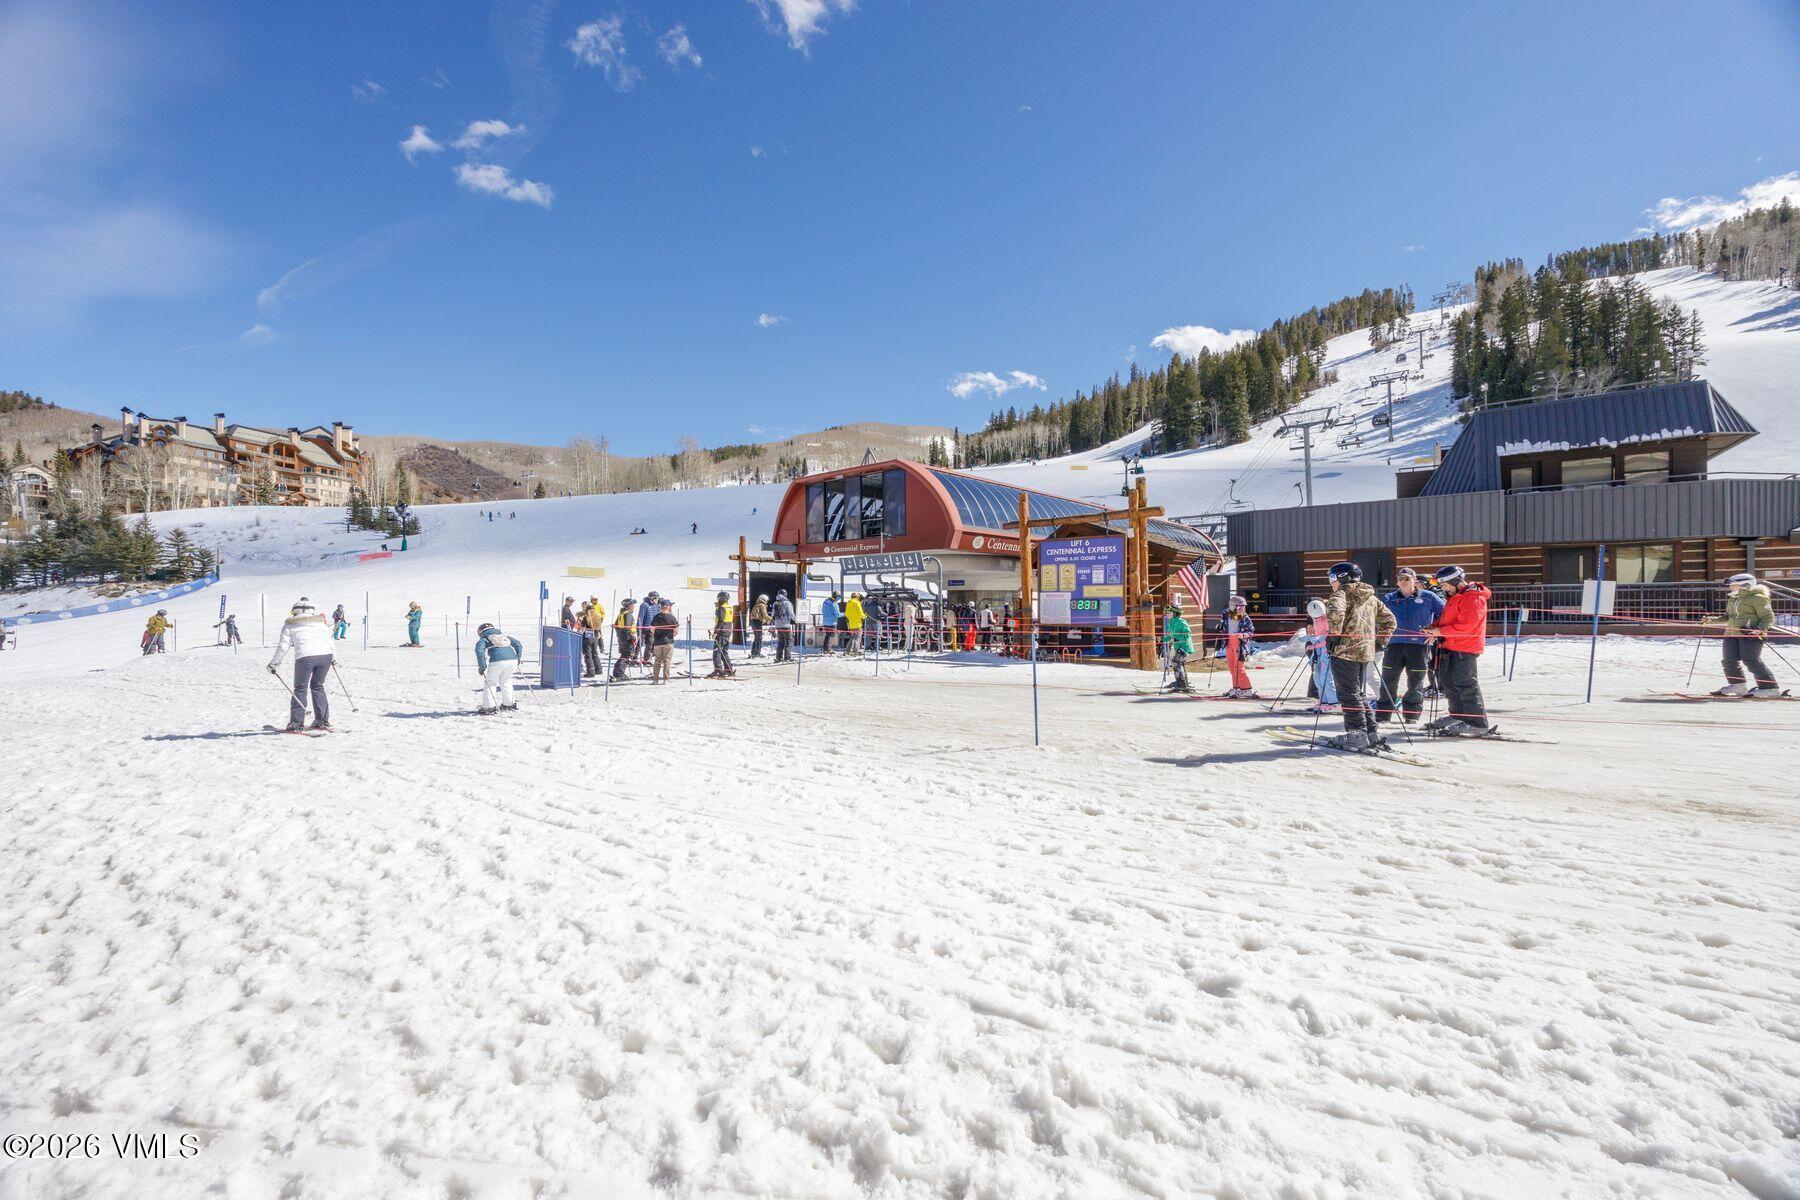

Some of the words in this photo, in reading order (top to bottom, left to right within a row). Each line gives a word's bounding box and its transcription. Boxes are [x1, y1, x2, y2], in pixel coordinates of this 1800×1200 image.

[830, 544, 858, 553] Centennial
[859, 543, 880, 551] Express
[1046, 547, 1085, 556] CENTENNIAL
[1087, 545, 1117, 554] EXPRESS
